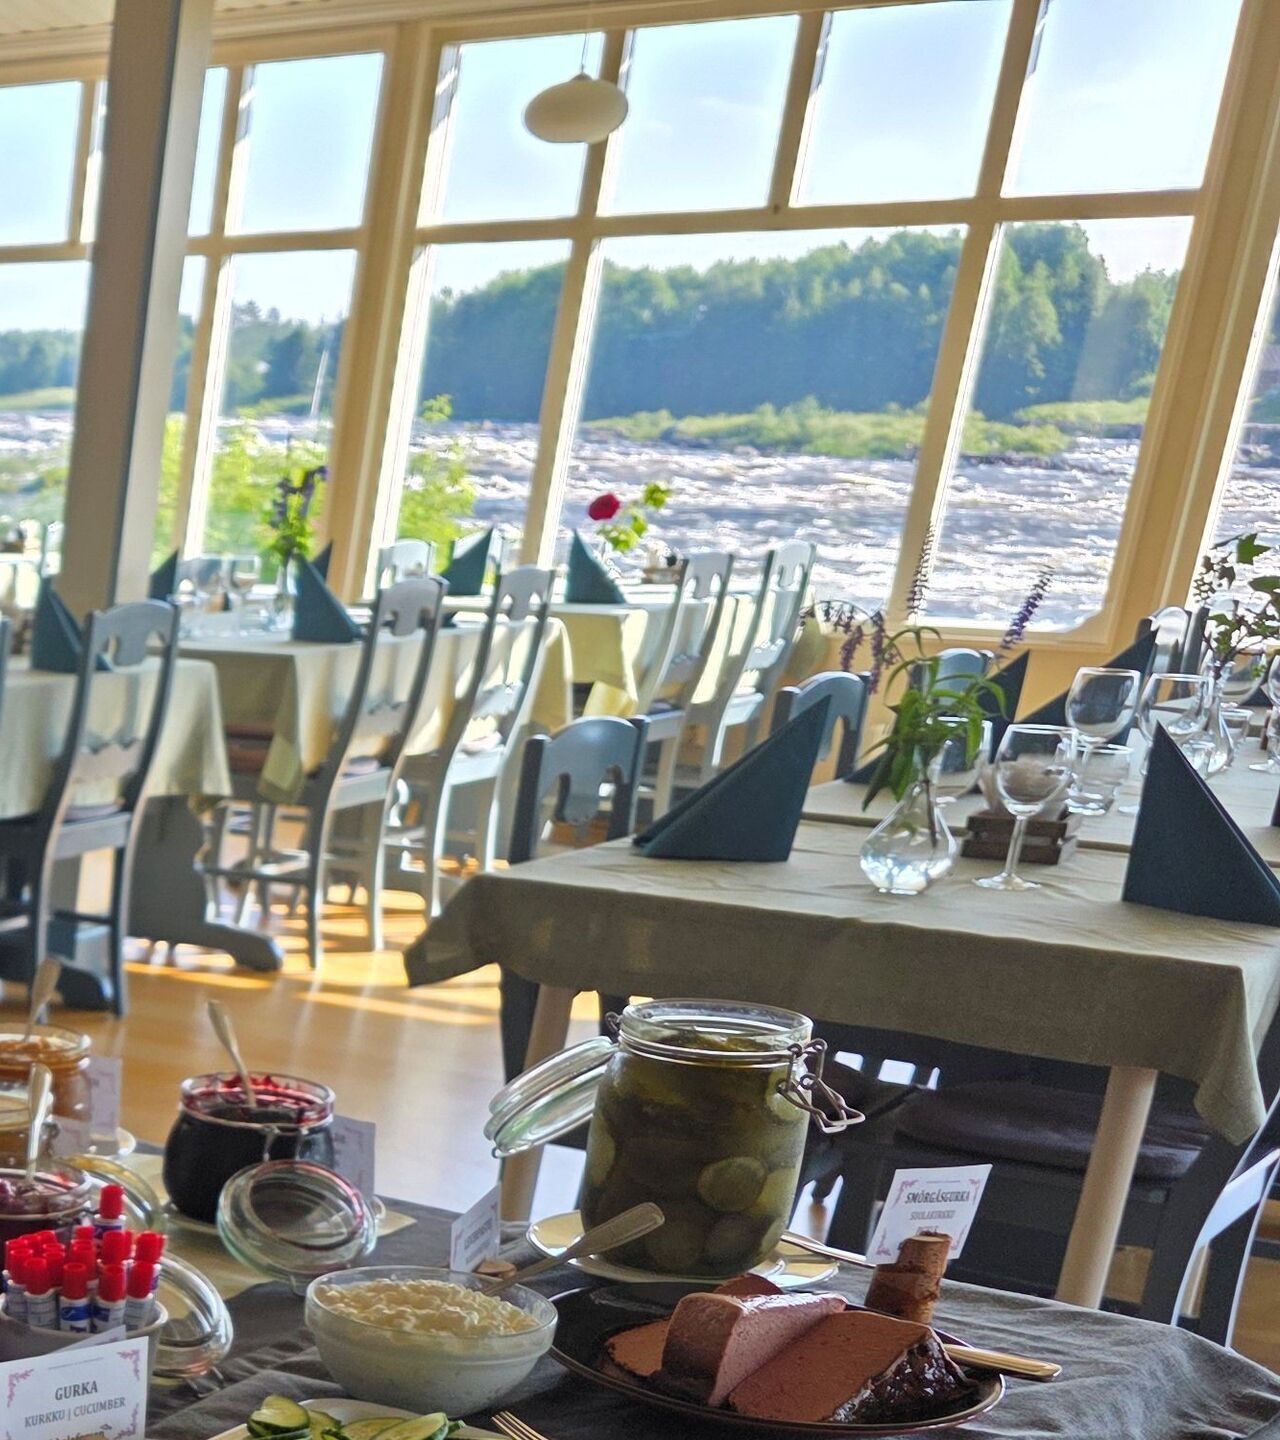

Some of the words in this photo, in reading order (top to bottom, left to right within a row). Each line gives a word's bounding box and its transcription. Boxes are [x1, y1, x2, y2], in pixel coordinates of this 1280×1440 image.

[55, 1380, 98, 1401] GURKA
[24, 1408, 65, 1428] KURKKU
[73, 1396, 126, 1417] CUCUMBER
